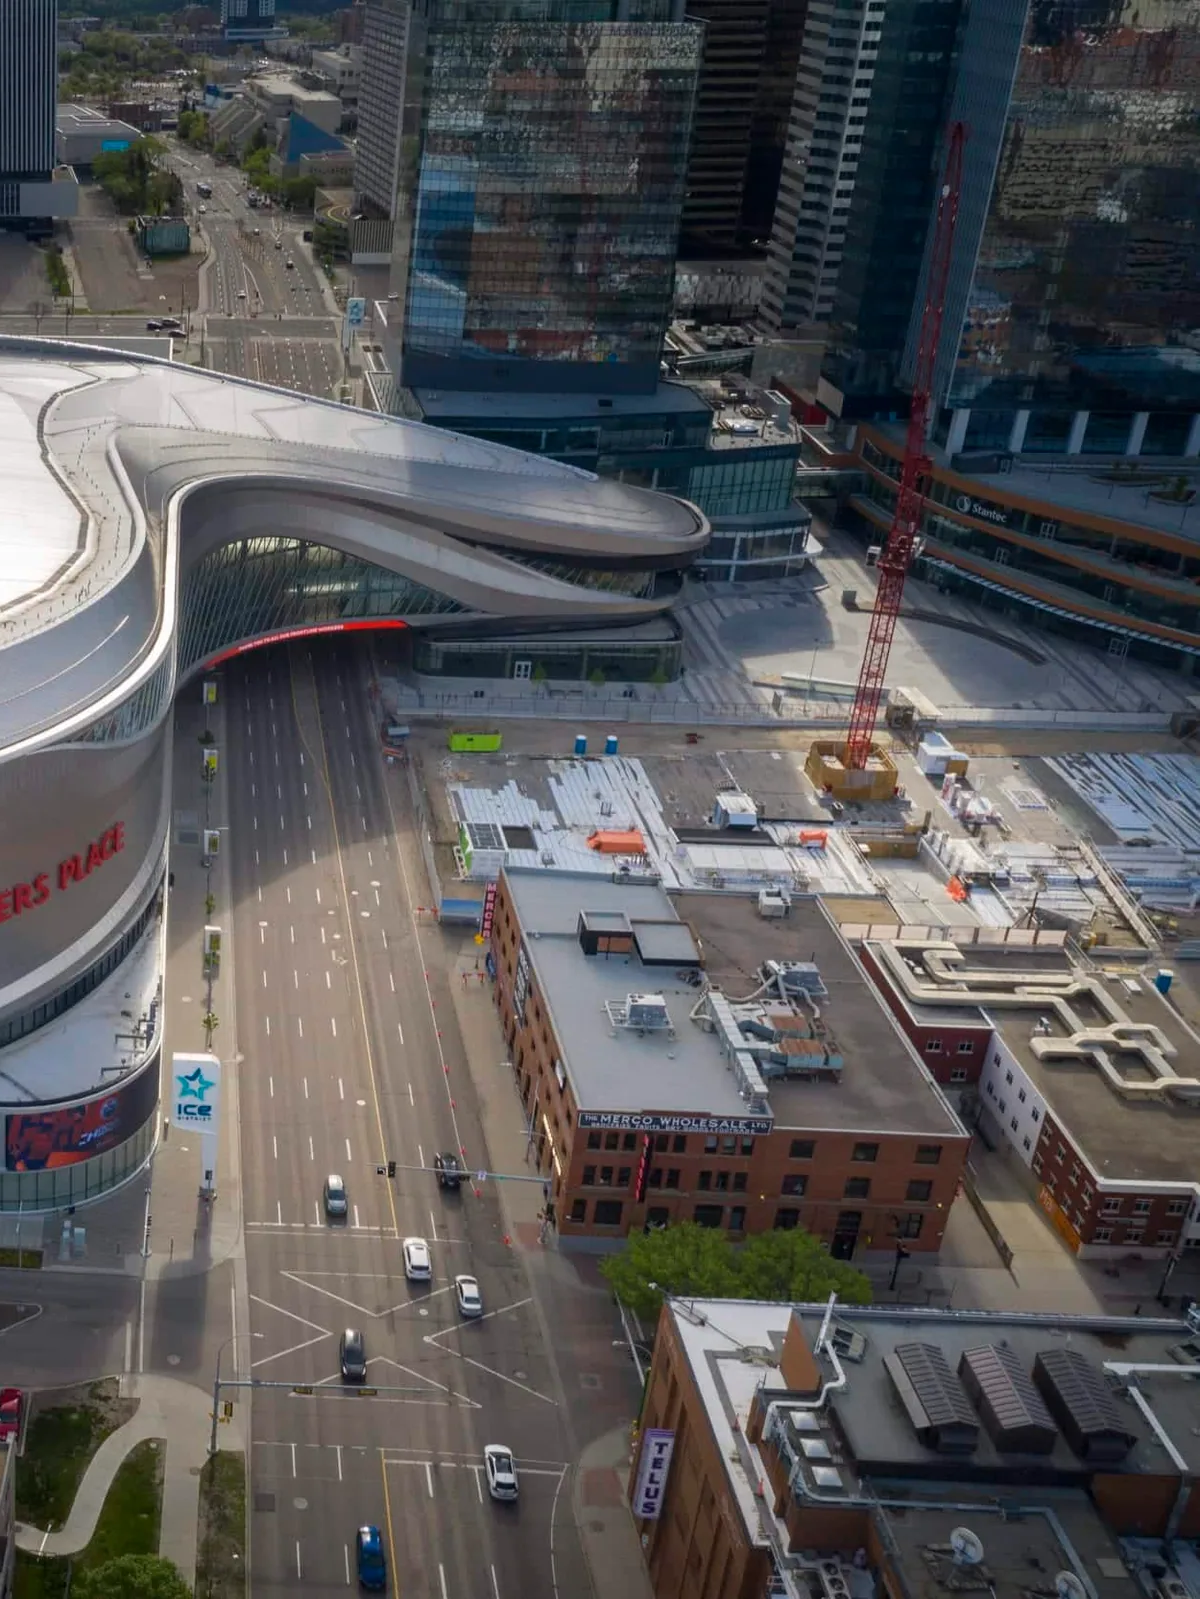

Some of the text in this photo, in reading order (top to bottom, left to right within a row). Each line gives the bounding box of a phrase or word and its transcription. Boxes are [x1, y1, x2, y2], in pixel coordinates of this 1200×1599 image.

[972, 503, 1007, 523] Stantec
[57, 821, 125, 891] PLACE
[483, 883, 497, 938] MERCER
[600, 1115, 653, 1125] MERCO
[660, 1117, 747, 1129] WHOLESALE
[641, 1442, 669, 1514] TELUS
